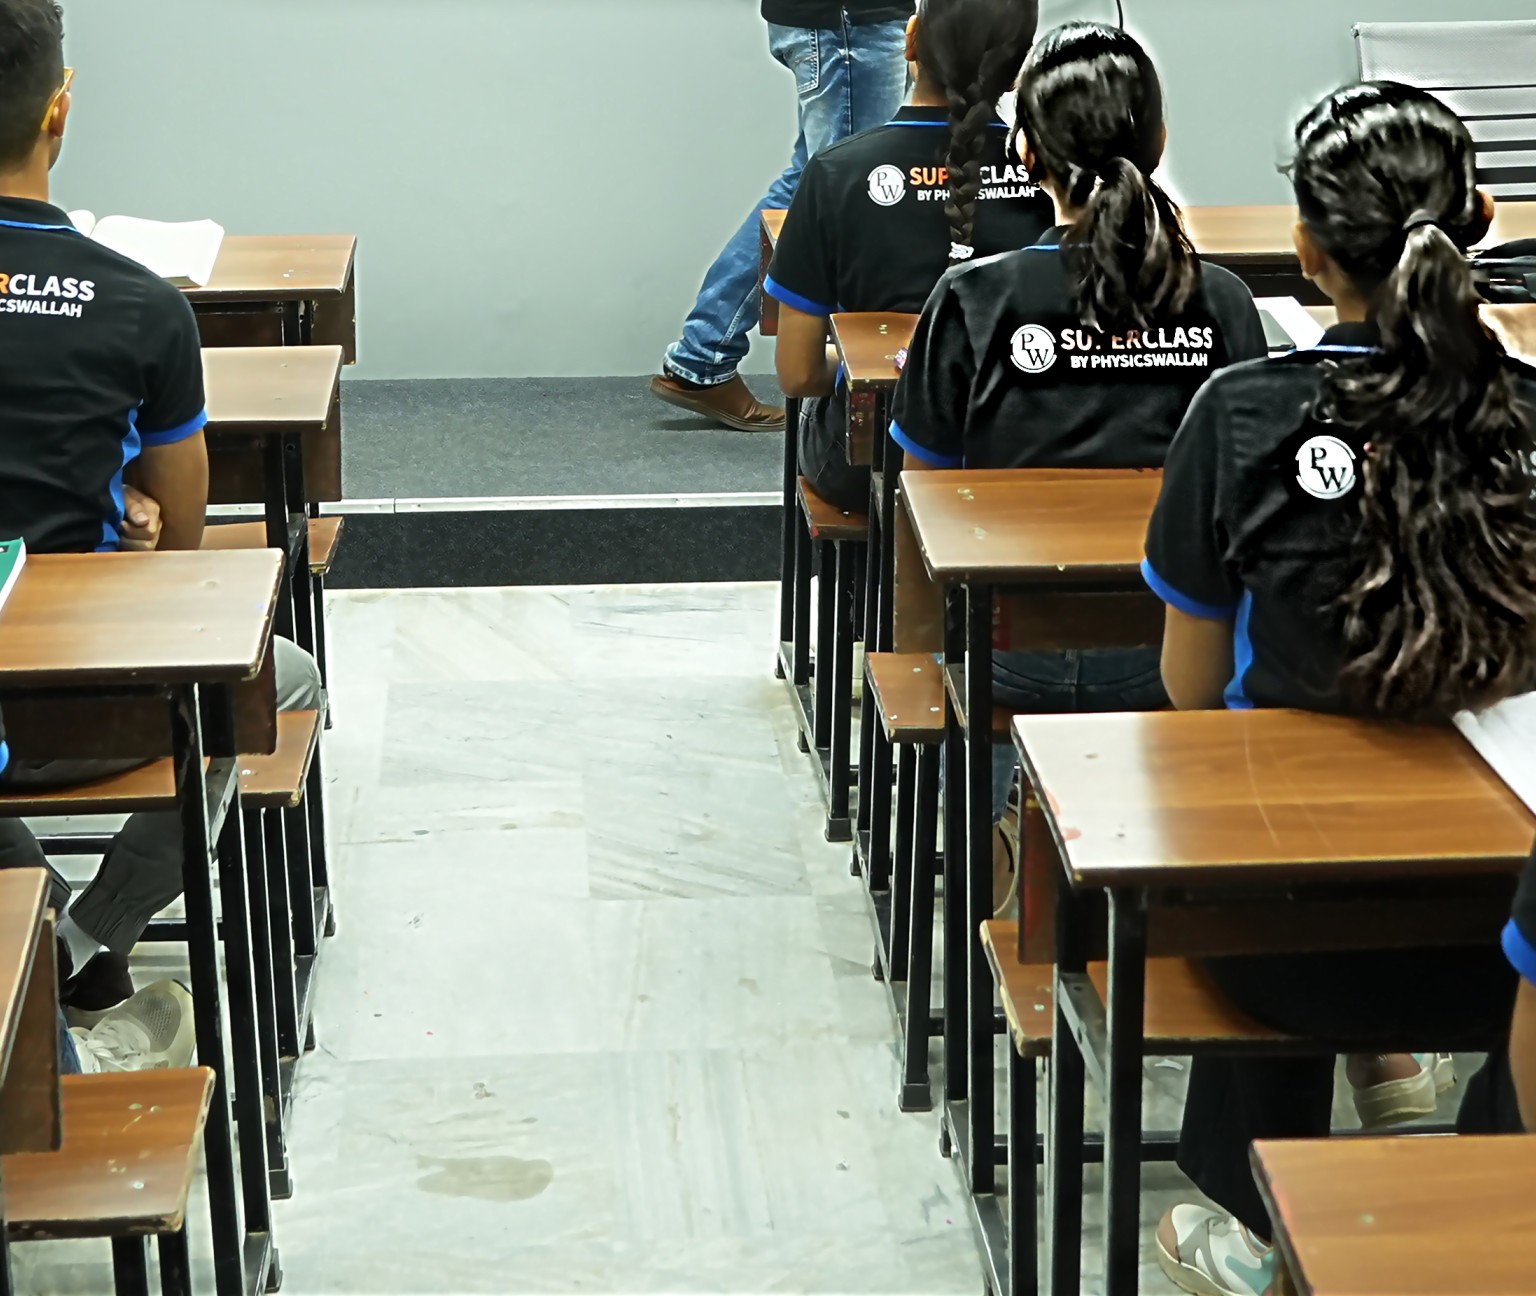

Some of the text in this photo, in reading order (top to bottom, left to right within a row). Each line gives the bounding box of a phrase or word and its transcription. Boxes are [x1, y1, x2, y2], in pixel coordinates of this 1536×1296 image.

[917, 189, 932, 201] BY
[1070, 353, 1208, 368] BY PHYSICSWALLAH
